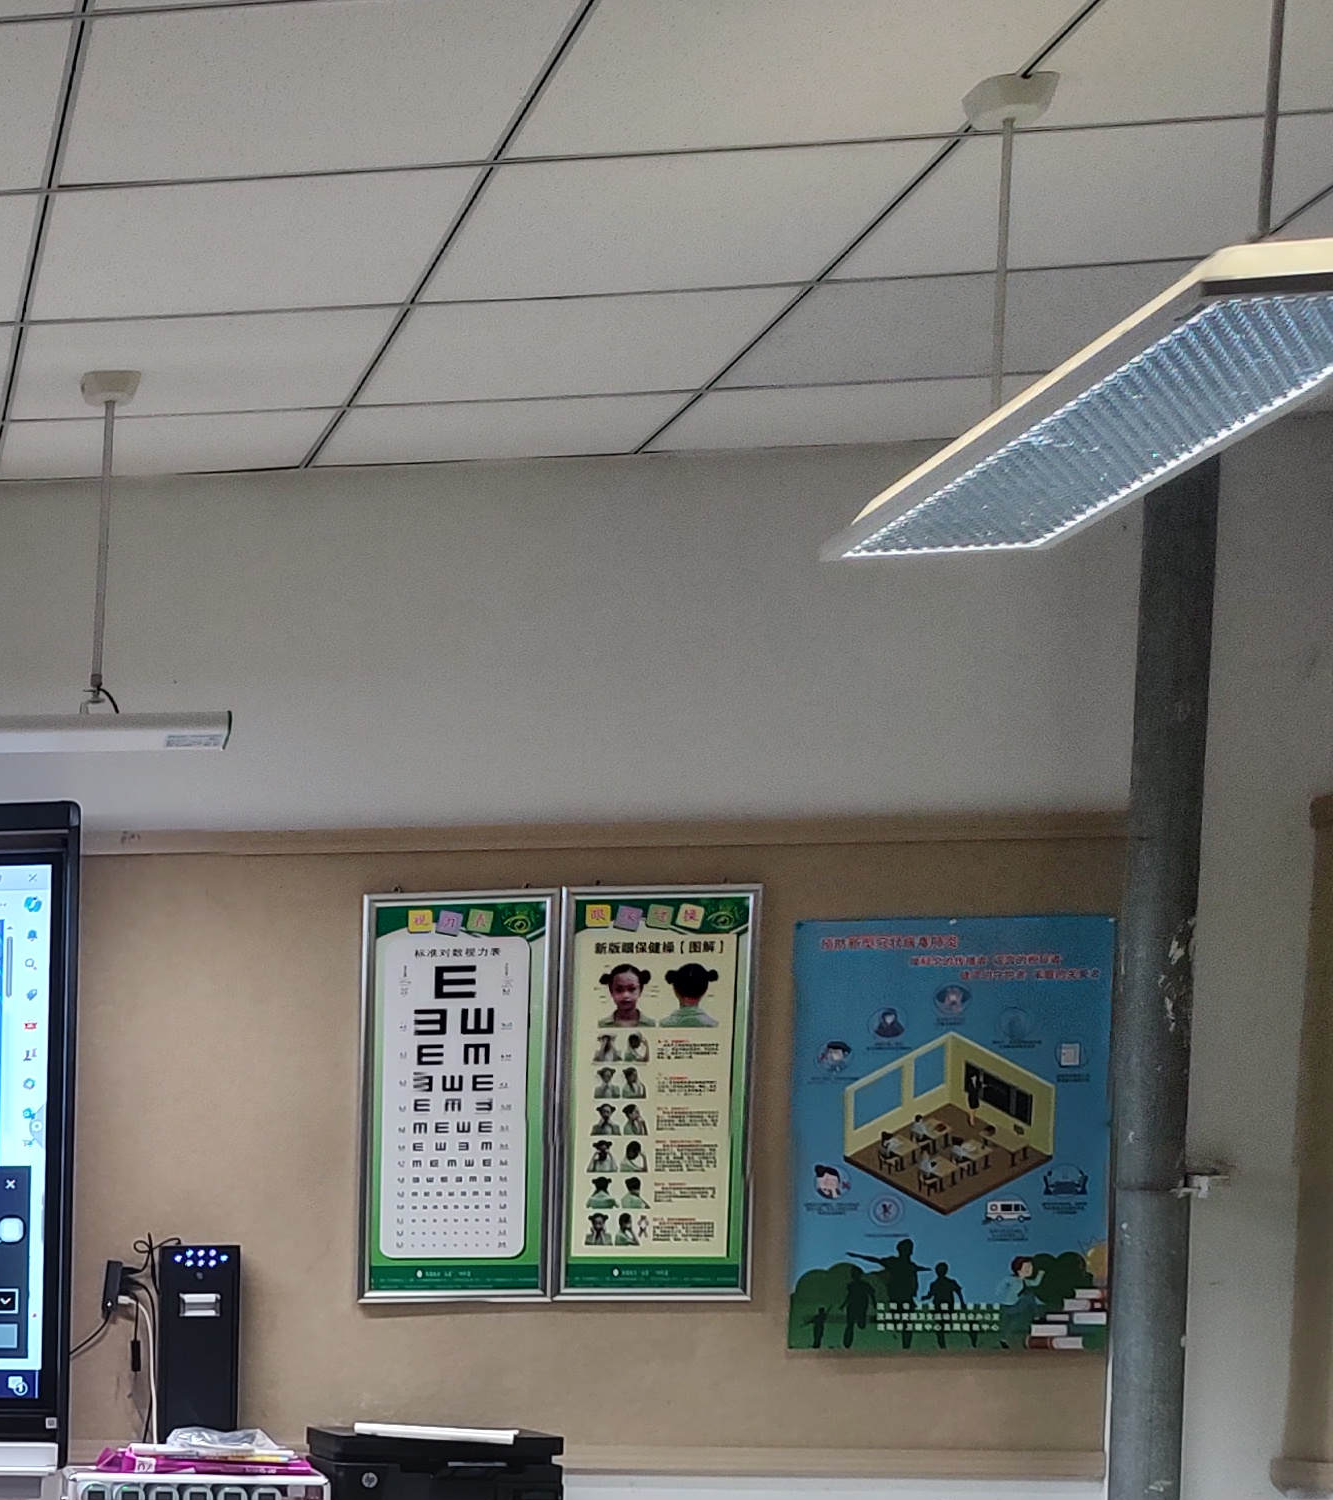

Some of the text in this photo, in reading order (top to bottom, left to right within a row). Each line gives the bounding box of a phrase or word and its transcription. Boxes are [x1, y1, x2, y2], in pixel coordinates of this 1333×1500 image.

[414, 947, 501, 958] 标准对数视力表
